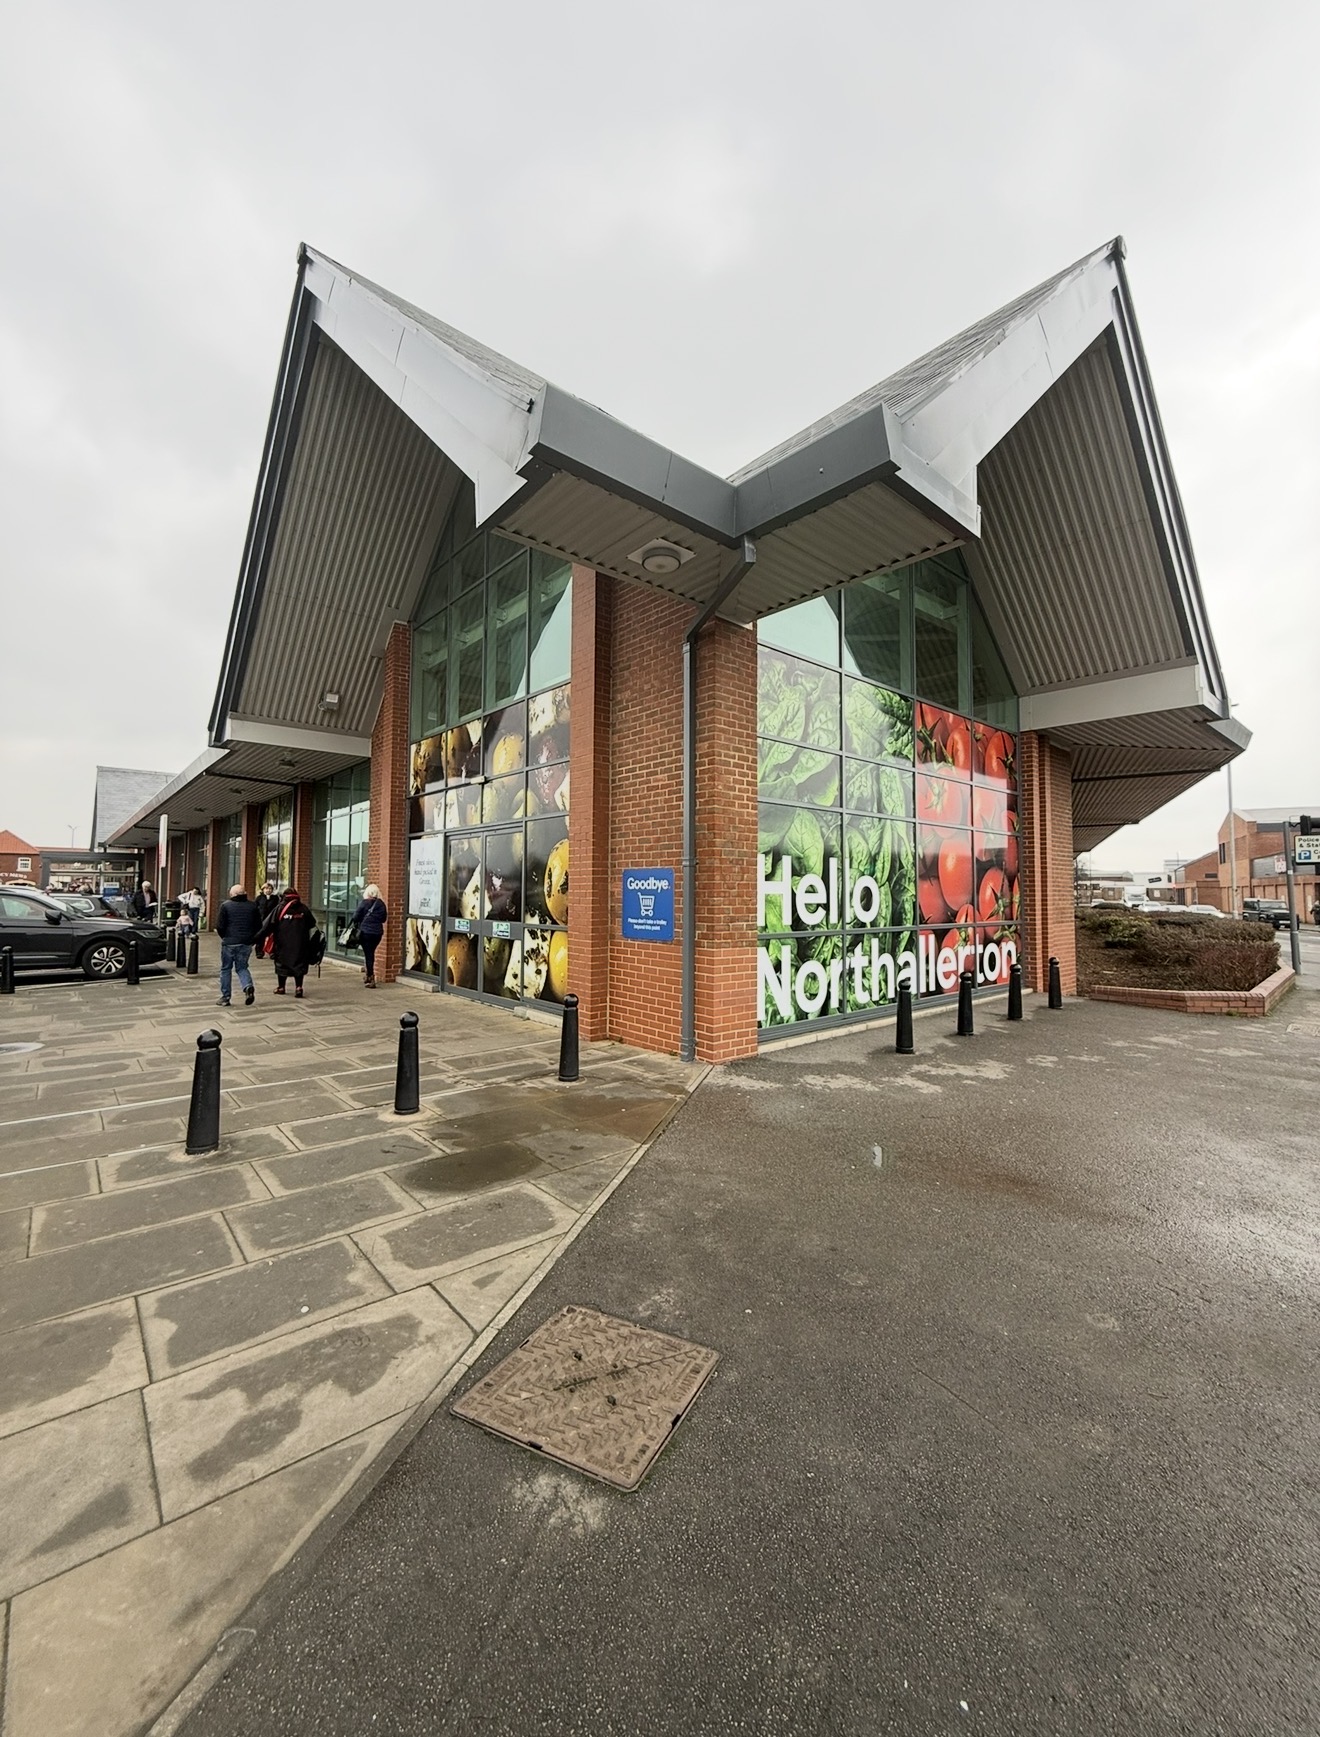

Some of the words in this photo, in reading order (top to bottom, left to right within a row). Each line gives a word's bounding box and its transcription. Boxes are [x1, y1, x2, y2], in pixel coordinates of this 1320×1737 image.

[627, 877, 671, 893] Goodbye.
[757, 853, 881, 927] Hello
[757, 934, 1018, 1021] Northallerton
